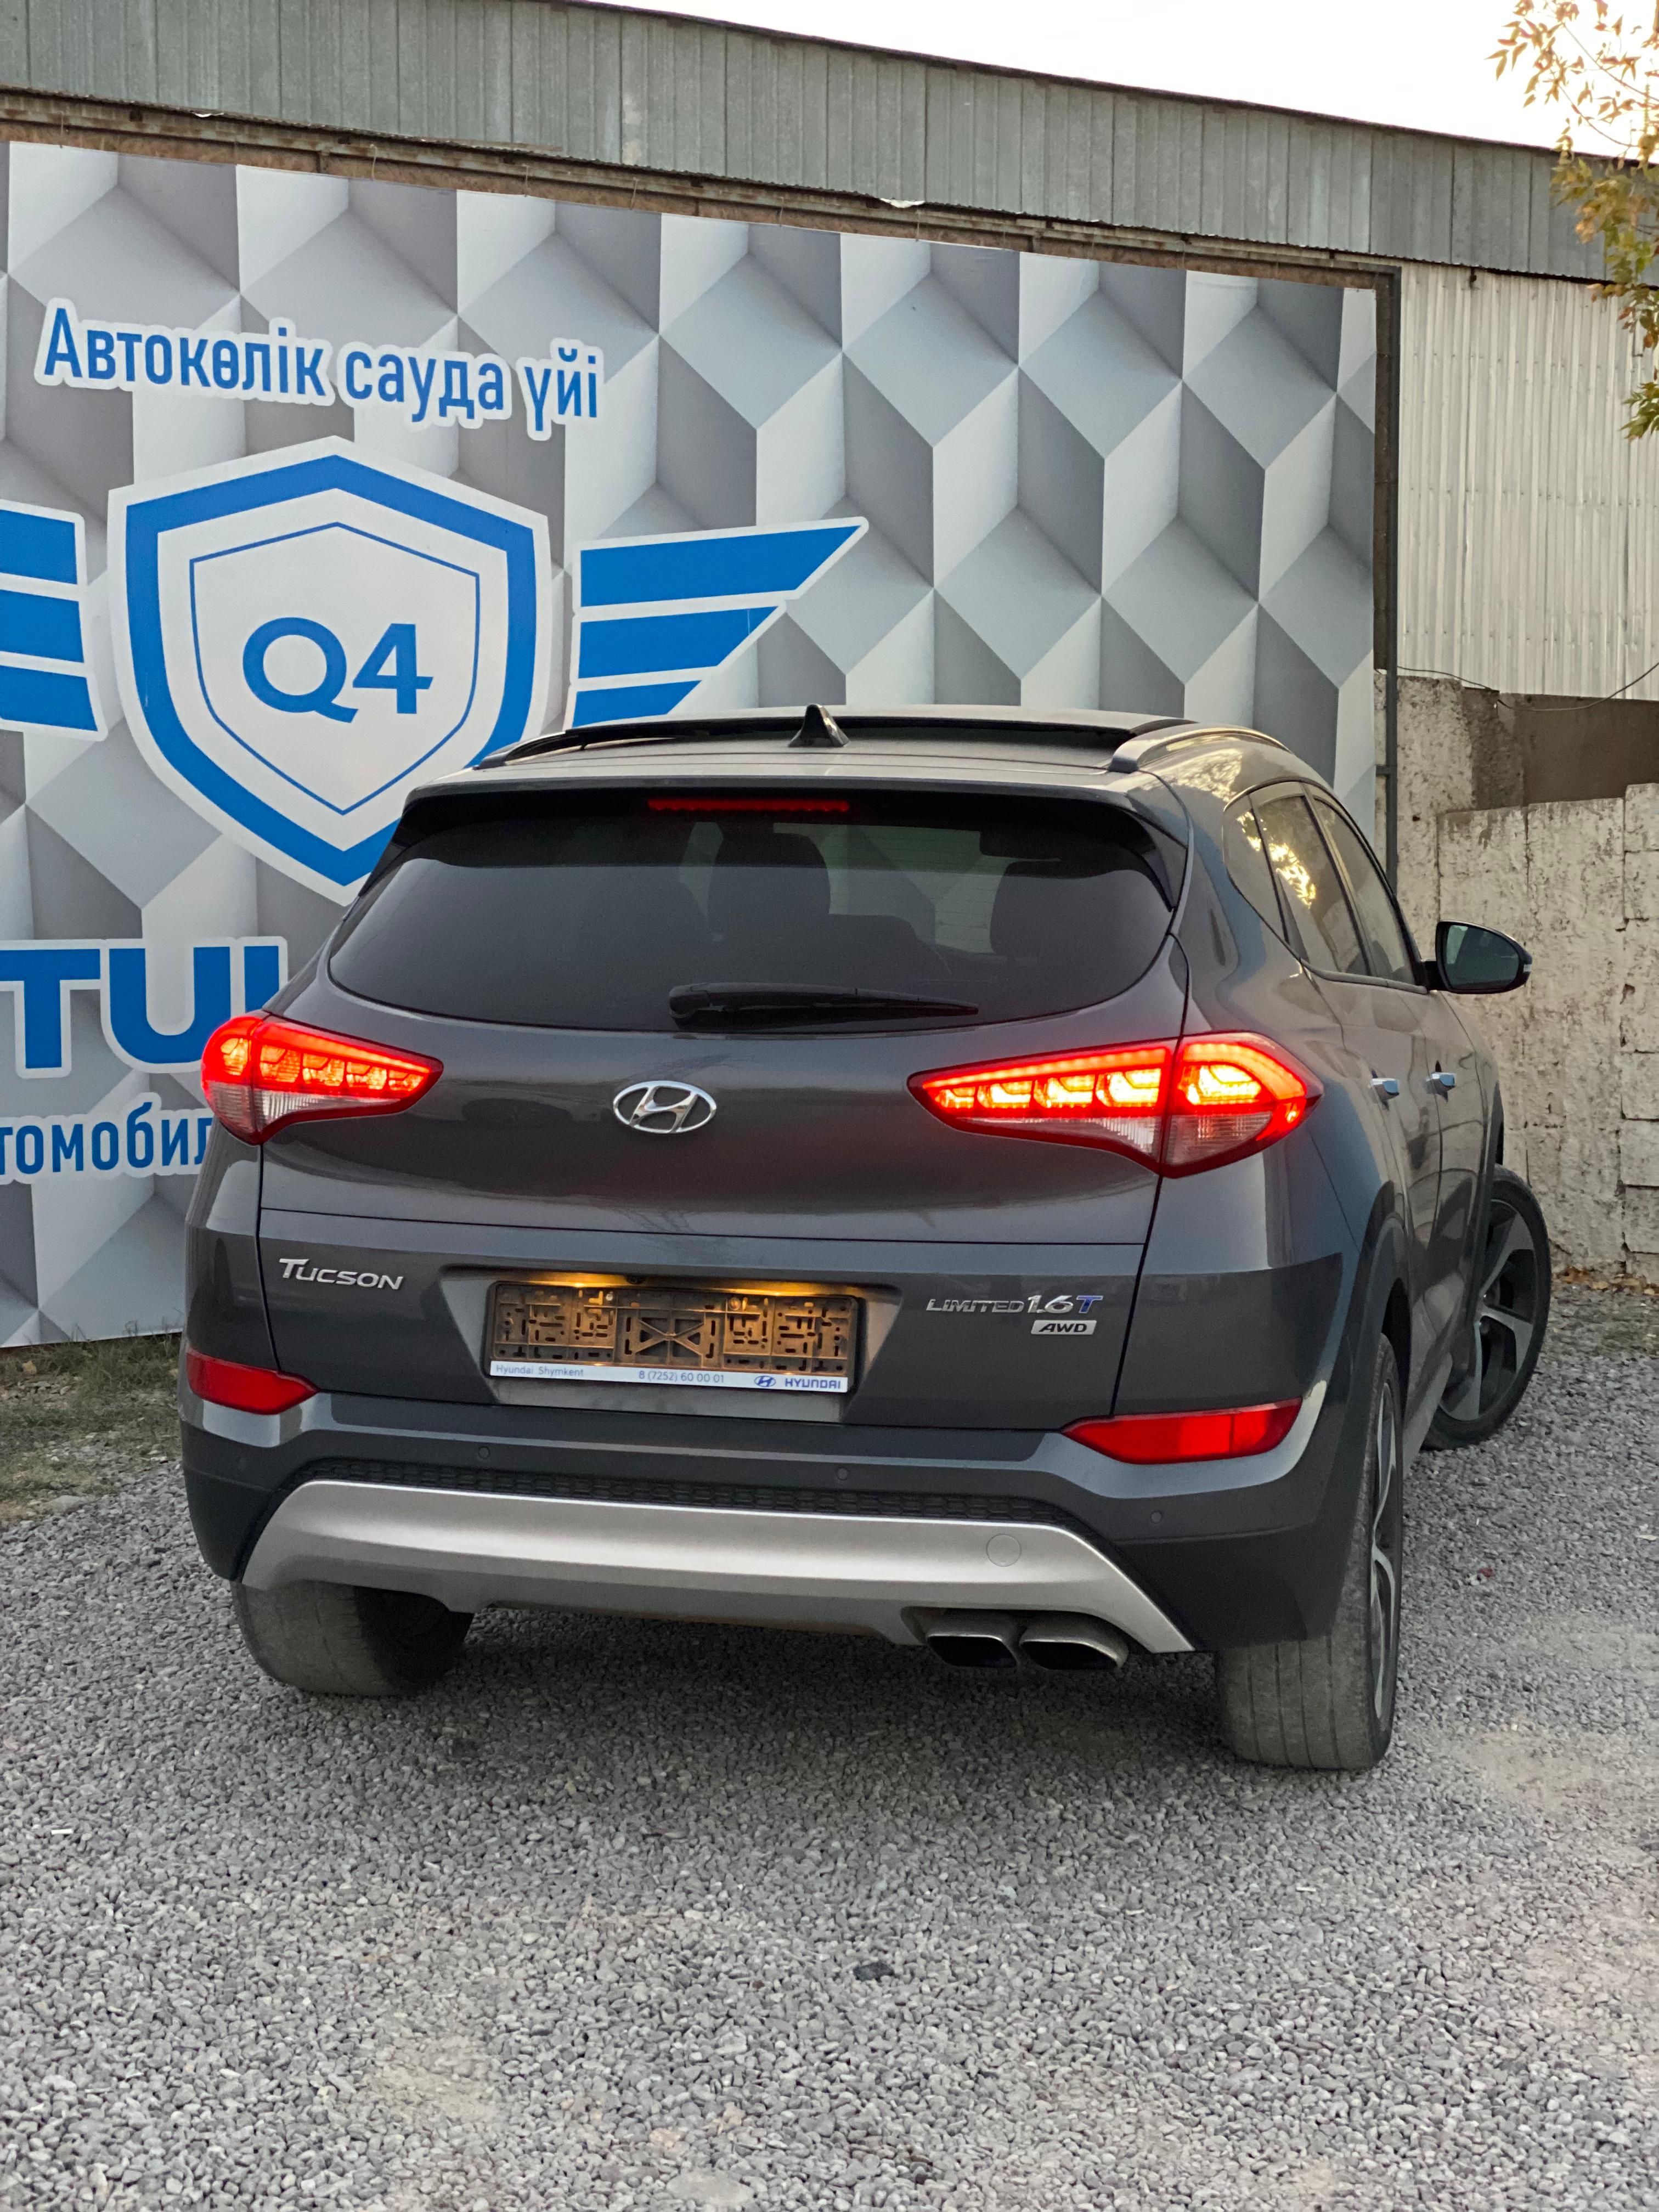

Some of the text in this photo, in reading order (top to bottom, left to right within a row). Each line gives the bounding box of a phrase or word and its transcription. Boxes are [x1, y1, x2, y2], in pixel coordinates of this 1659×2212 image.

[44, 308, 597, 431] Автокөлік сауда үйі
[242, 617, 433, 723] Q4
[926, 1299, 1024, 1313] LIMITED
[1039, 1323, 1087, 1333] TUCSON
[496, 1364, 584, 1378] Hyundai Shymkent
[639, 1370, 724, 1383] 8 (7252) 60 00 01
[785, 1378, 841, 1389] HYUNDAI
